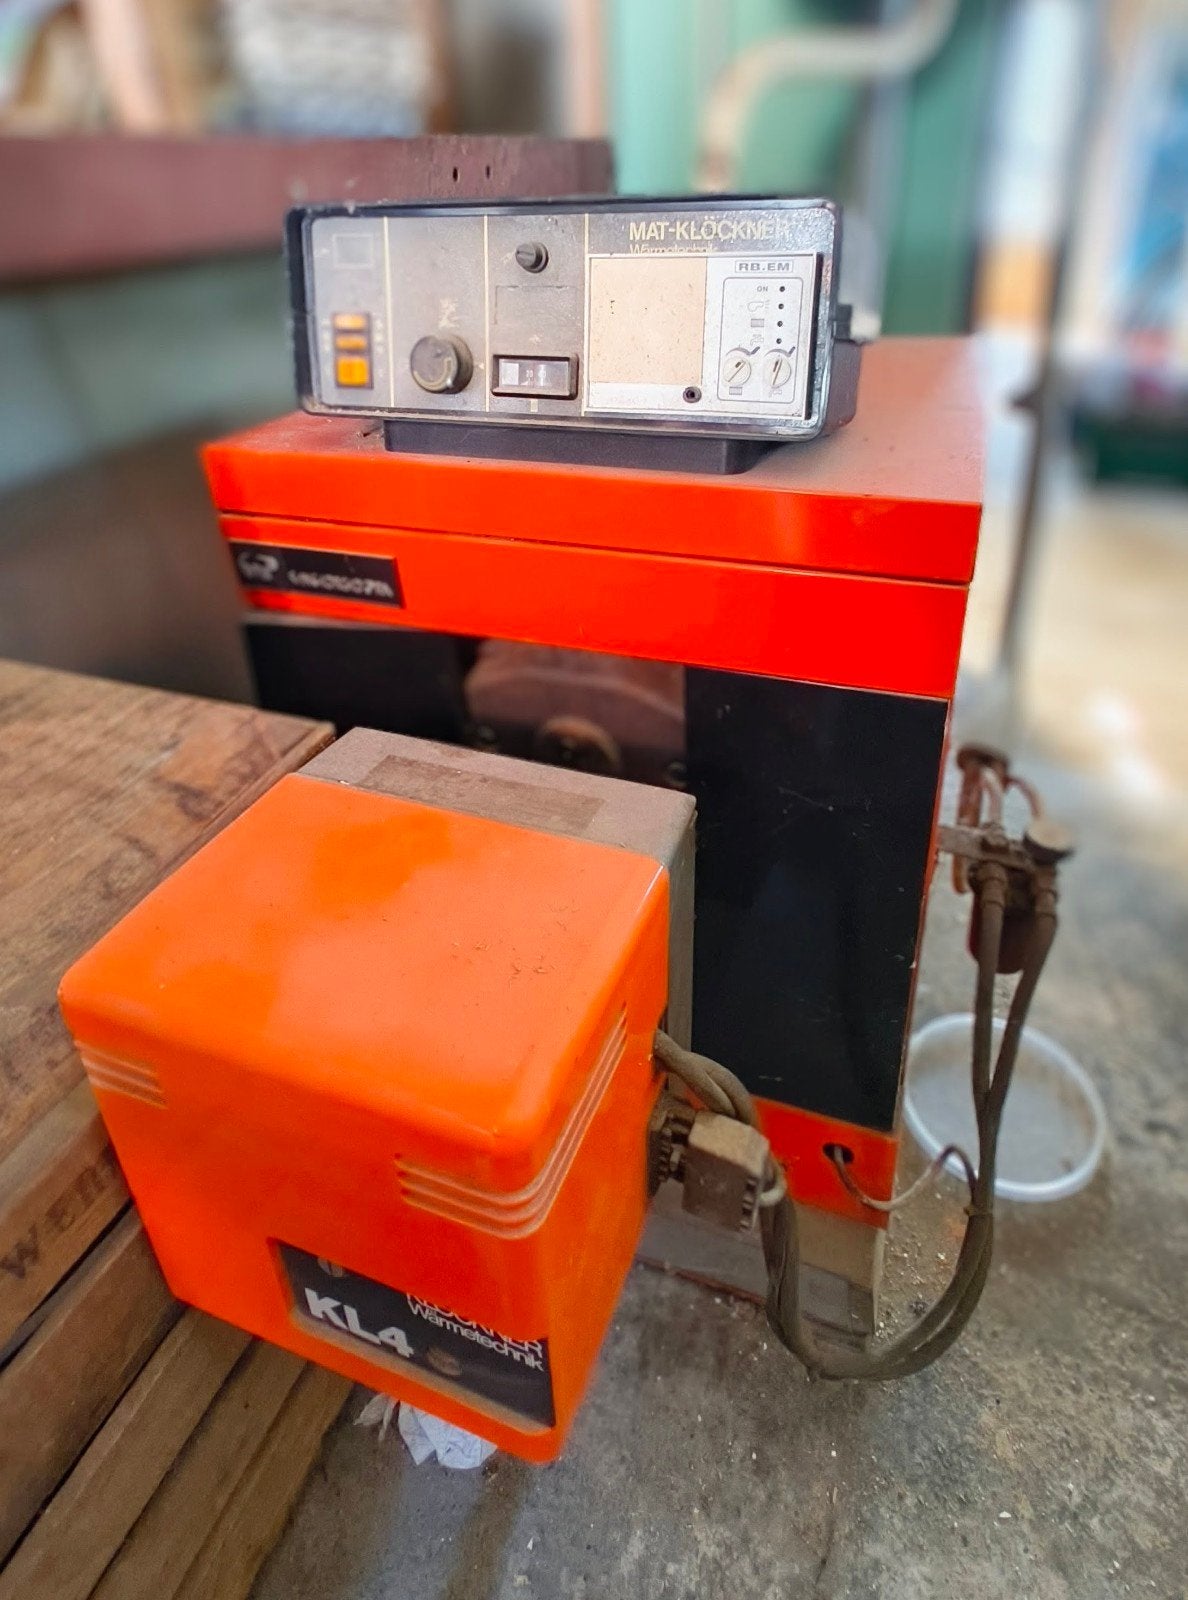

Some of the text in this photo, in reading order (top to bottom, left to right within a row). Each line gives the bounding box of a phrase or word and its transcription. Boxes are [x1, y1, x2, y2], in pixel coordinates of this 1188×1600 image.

[738, 262, 790, 272] RB.EM
[756, 285, 769, 293] ON
[305, 1287, 415, 1358] KL4
